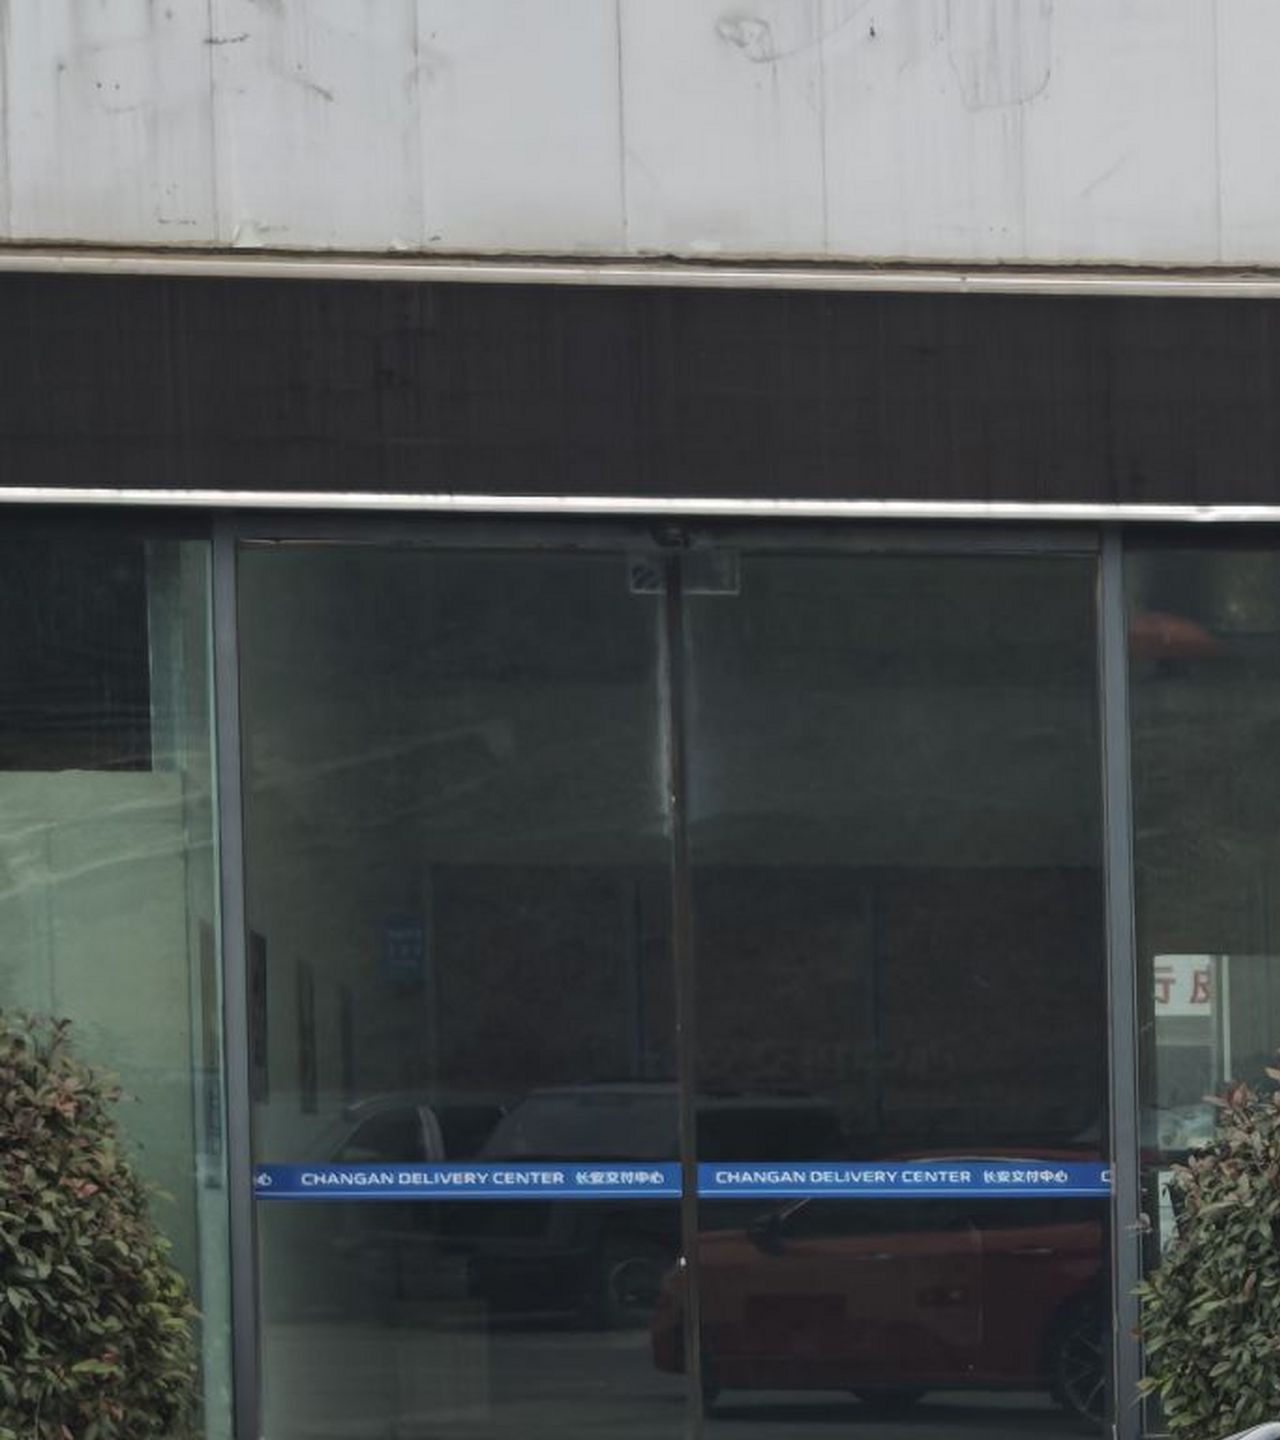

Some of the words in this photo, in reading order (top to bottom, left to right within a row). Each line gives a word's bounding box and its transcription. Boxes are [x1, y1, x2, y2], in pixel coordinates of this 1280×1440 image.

[301, 1172, 394, 1186] CHANGAN
[398, 1172, 489, 1185] DELIVERY
[492, 1171, 565, 1185] CENTER
[575, 1171, 665, 1186] 长安交付中心
[715, 1171, 806, 1184] CHANGAN
[810, 1170, 898, 1183] DELIVERY
[901, 1170, 971, 1183] CENTER
[983, 1169, 1068, 1184] 长安交付中心
